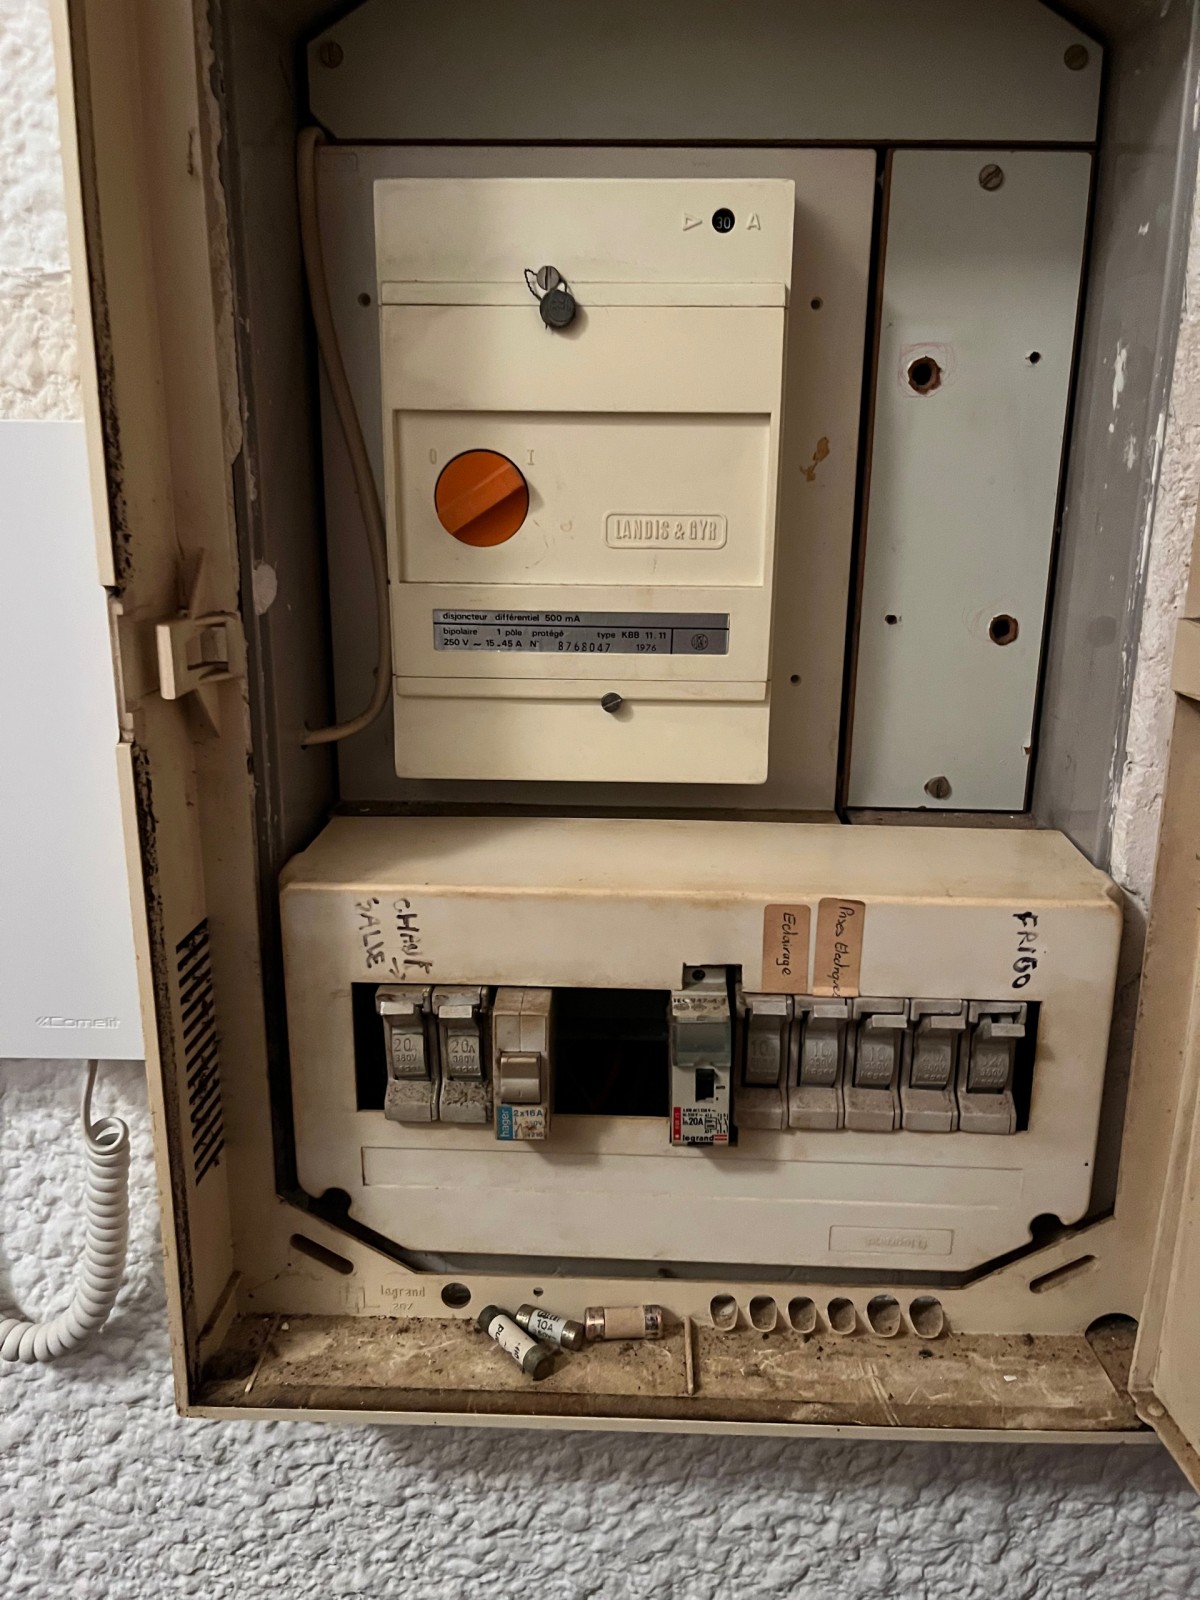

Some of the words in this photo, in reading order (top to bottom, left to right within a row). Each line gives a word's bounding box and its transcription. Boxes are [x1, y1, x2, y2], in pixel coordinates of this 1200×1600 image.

[616, 519, 670, 541] LANDIS
[674, 521, 686, 541] &
[689, 519, 718, 541] GYR
[442, 612, 488, 622] disjoncteur
[494, 612, 540, 622] différentiel
[544, 614, 563, 622] 500
[442, 627, 478, 636] bipolaire
[505, 628, 523, 637] pôle
[532, 630, 564, 639] protégé
[597, 631, 616, 639] type
[621, 631, 640, 639] KBB
[515, 640, 523, 648] A
[558, 641, 611, 652] 8768047
[636, 643, 657, 652] 1976
[354, 897, 385, 969] SALLE
[775, 912, 799, 977] Eclairage
[500, 1109, 511, 1137] hager
[688, 1117, 704, 1126] 20A
[683, 1134, 714, 1143] legrand
[380, 1284, 426, 1300] legrand
[536, 1319, 553, 1333] 10A
